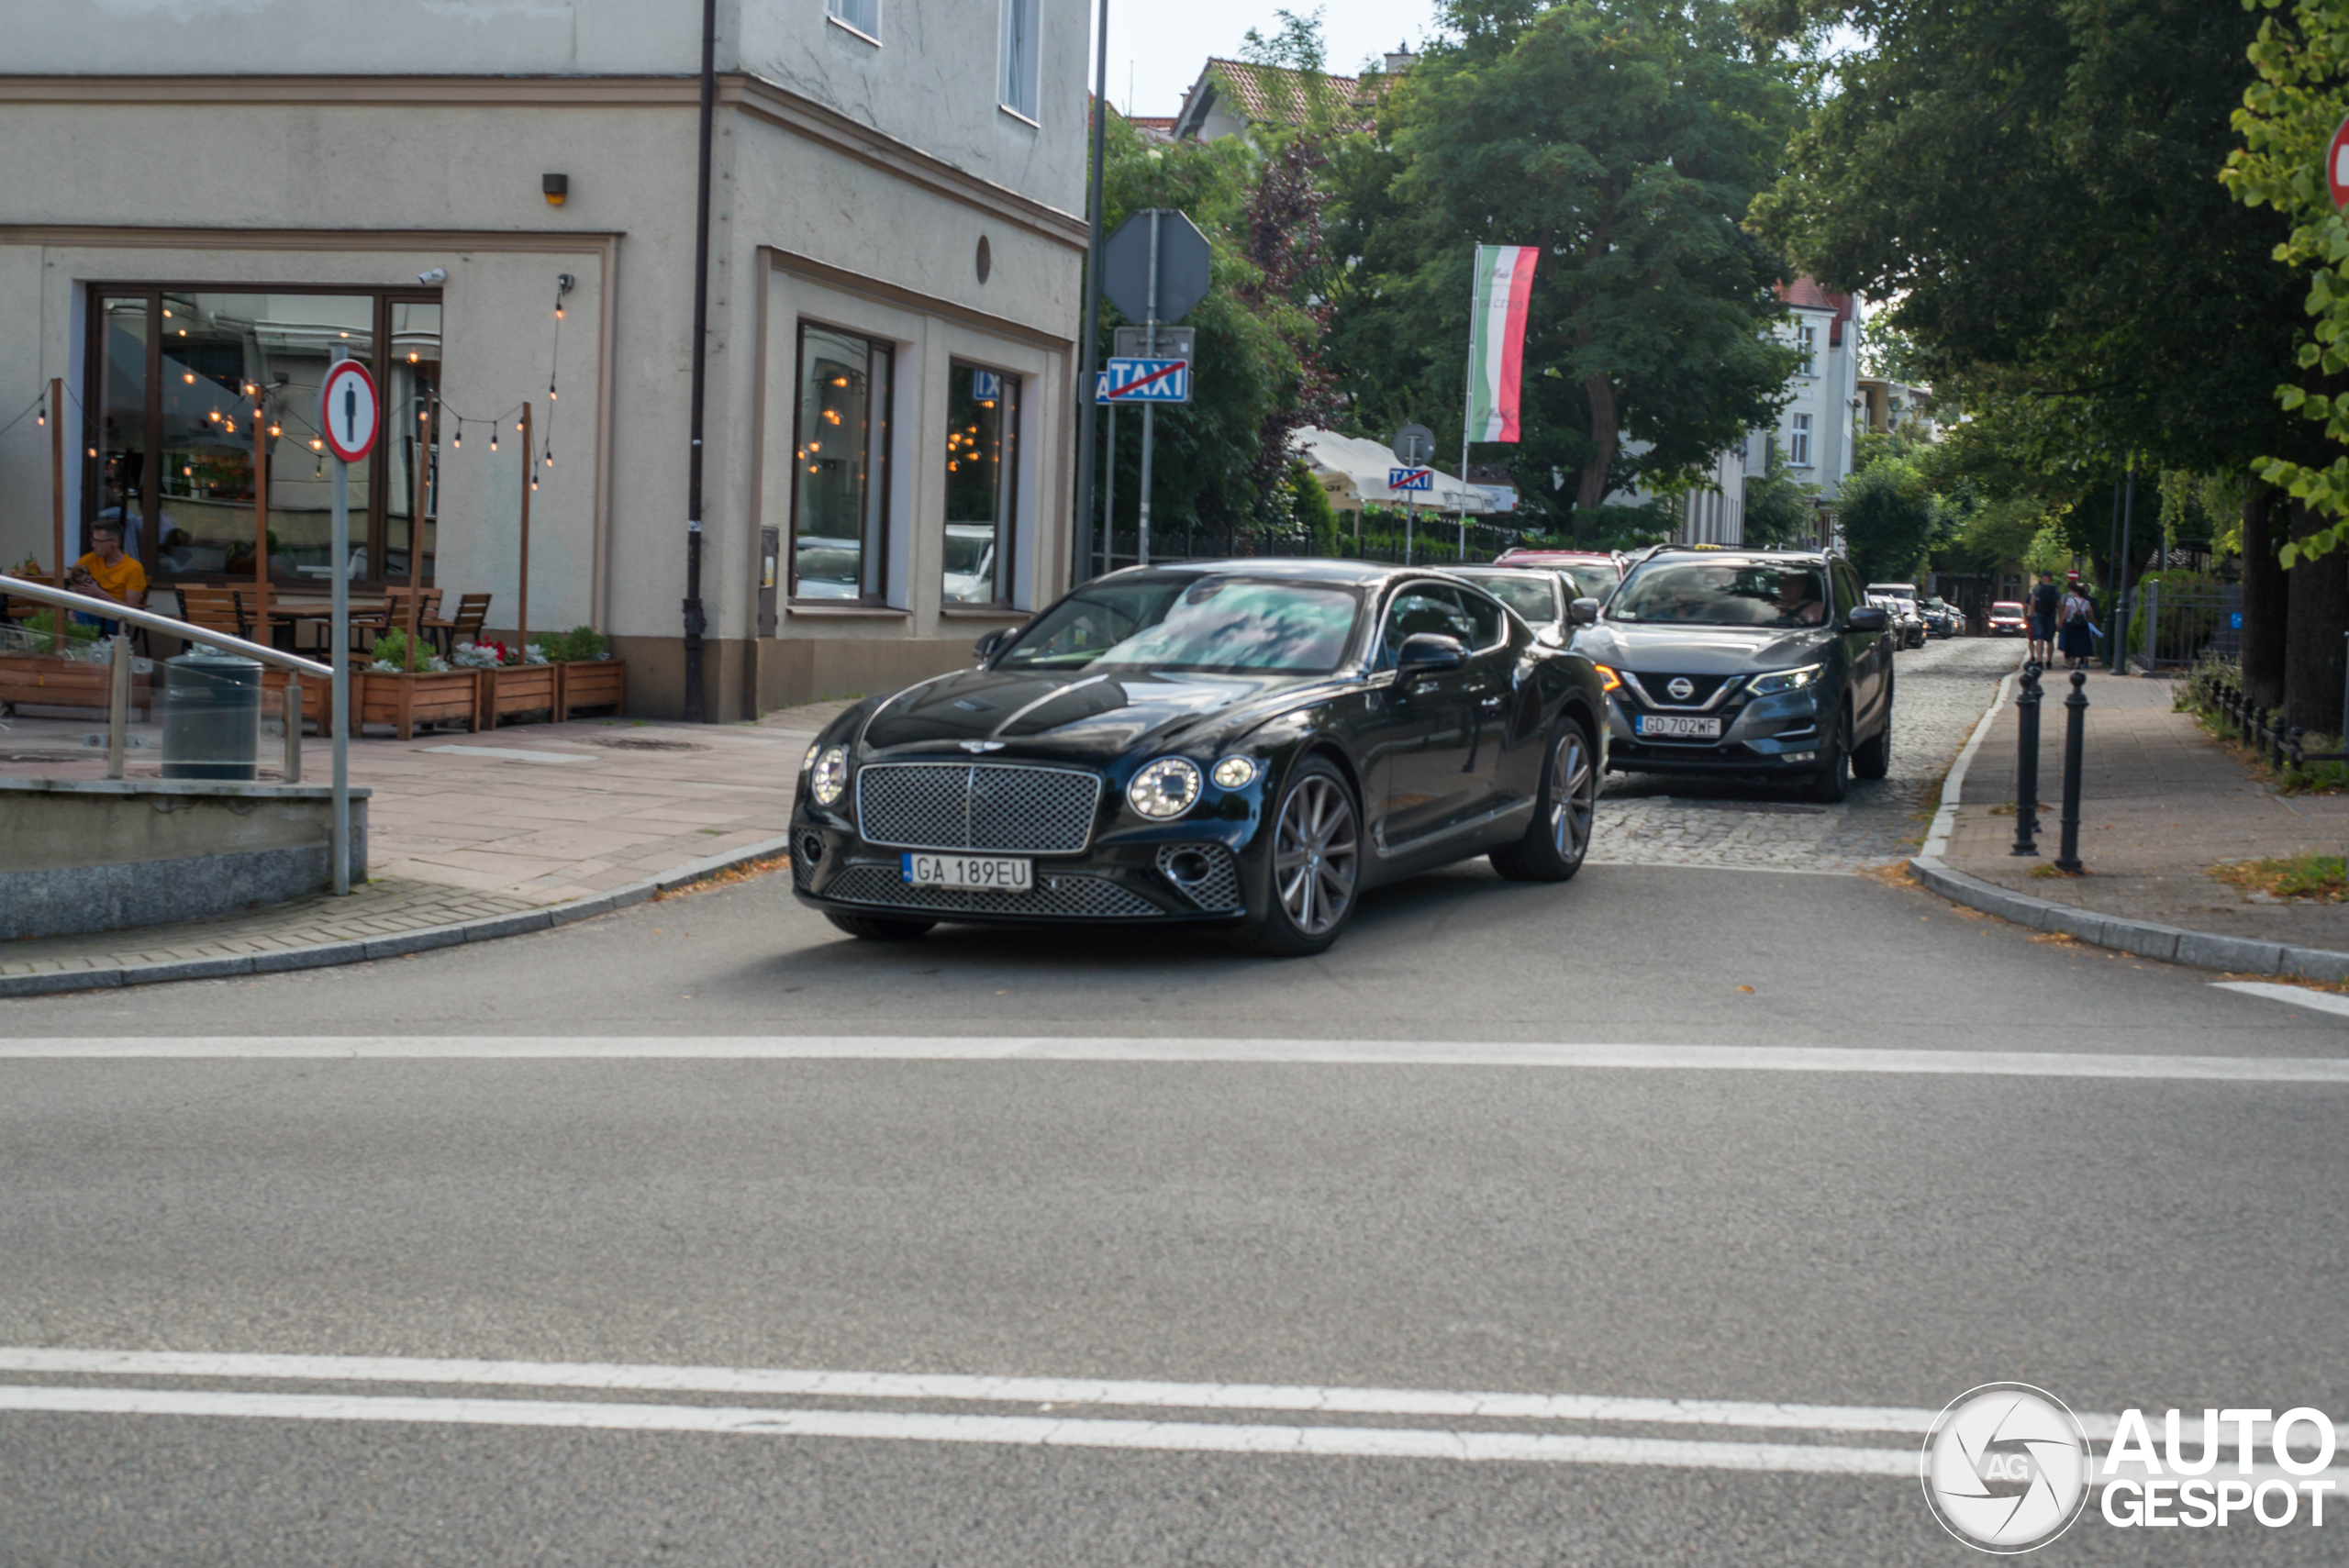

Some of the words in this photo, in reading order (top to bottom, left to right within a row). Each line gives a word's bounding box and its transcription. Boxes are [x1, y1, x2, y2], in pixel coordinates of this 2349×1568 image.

[1110, 363, 1182, 396] TAXI
[1390, 470, 1429, 488] TAXI
[1645, 717, 1665, 732] GD
[1671, 718, 1717, 733] 702WF
[917, 857, 945, 882] GA
[956, 860, 1026, 885] 189EU
